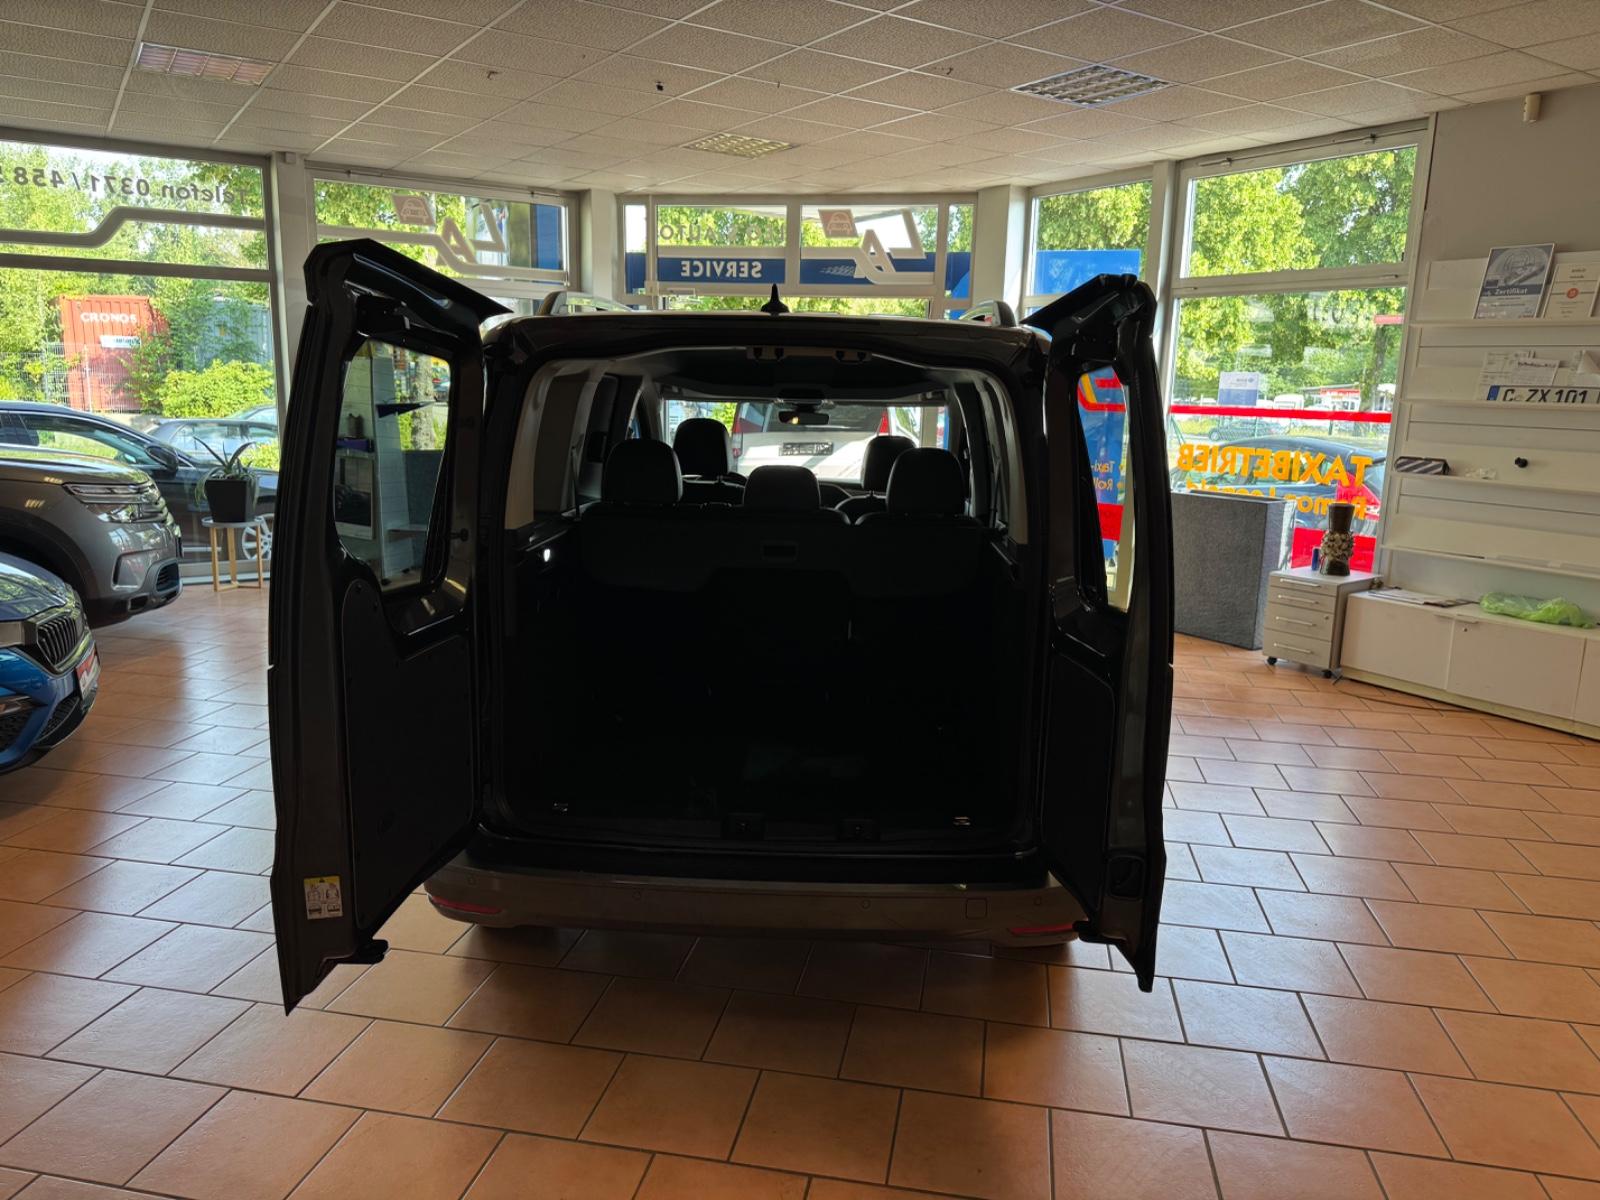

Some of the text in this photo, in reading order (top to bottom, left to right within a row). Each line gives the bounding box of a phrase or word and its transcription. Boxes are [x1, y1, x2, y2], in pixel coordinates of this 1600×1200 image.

[1494, 287, 1529, 296] Zertifikat
[1525, 388, 1552, 404] ZX
[1554, 389, 1588, 404] 101
